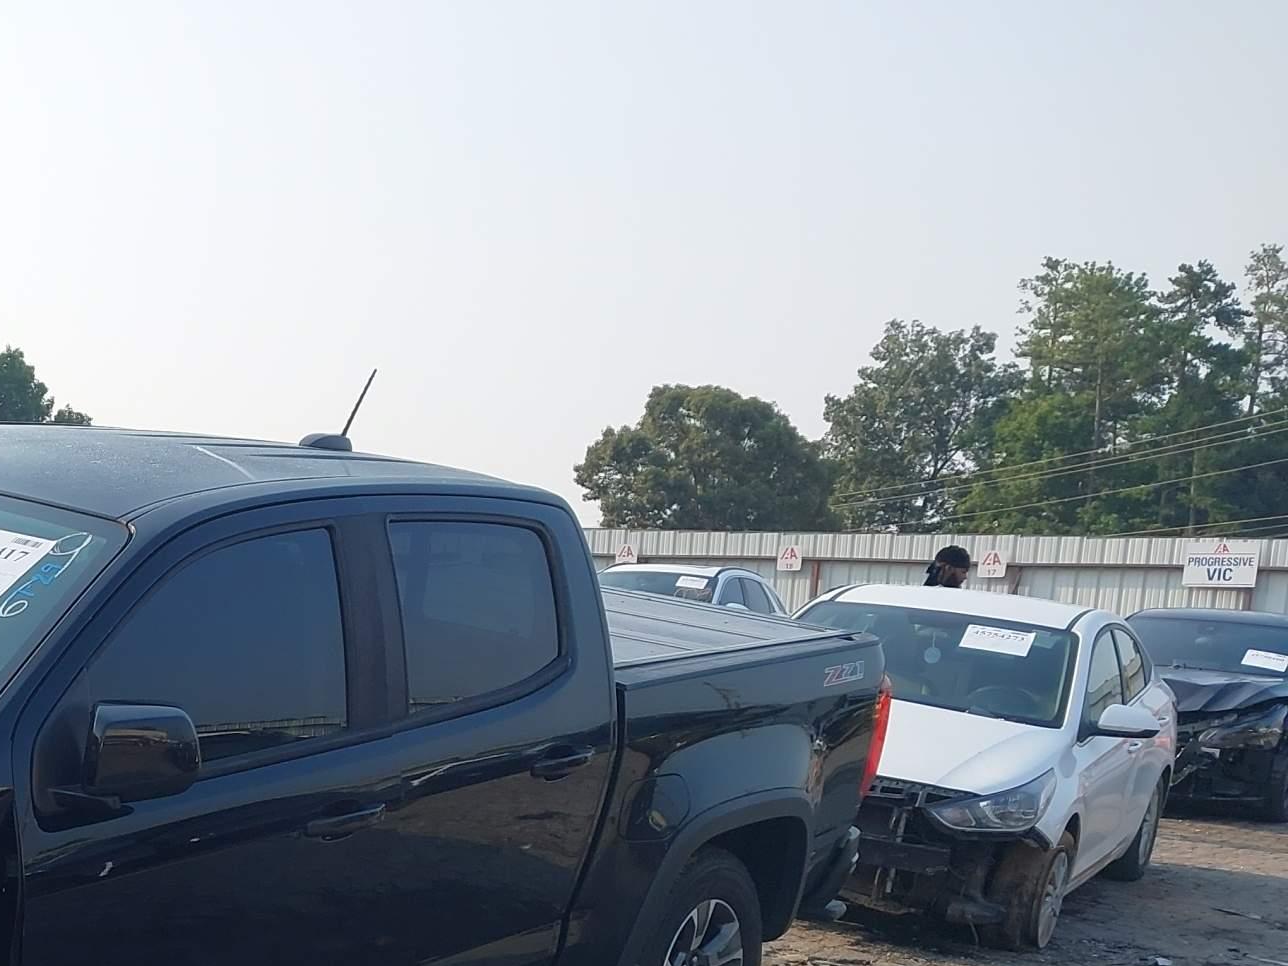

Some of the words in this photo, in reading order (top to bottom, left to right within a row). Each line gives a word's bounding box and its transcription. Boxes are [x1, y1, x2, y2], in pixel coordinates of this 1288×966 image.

[1188, 556, 1255, 567] PROGRESSIVE
[987, 568, 997, 576] 17
[1206, 567, 1233, 582] VIC
[824, 660, 865, 687] Z71
